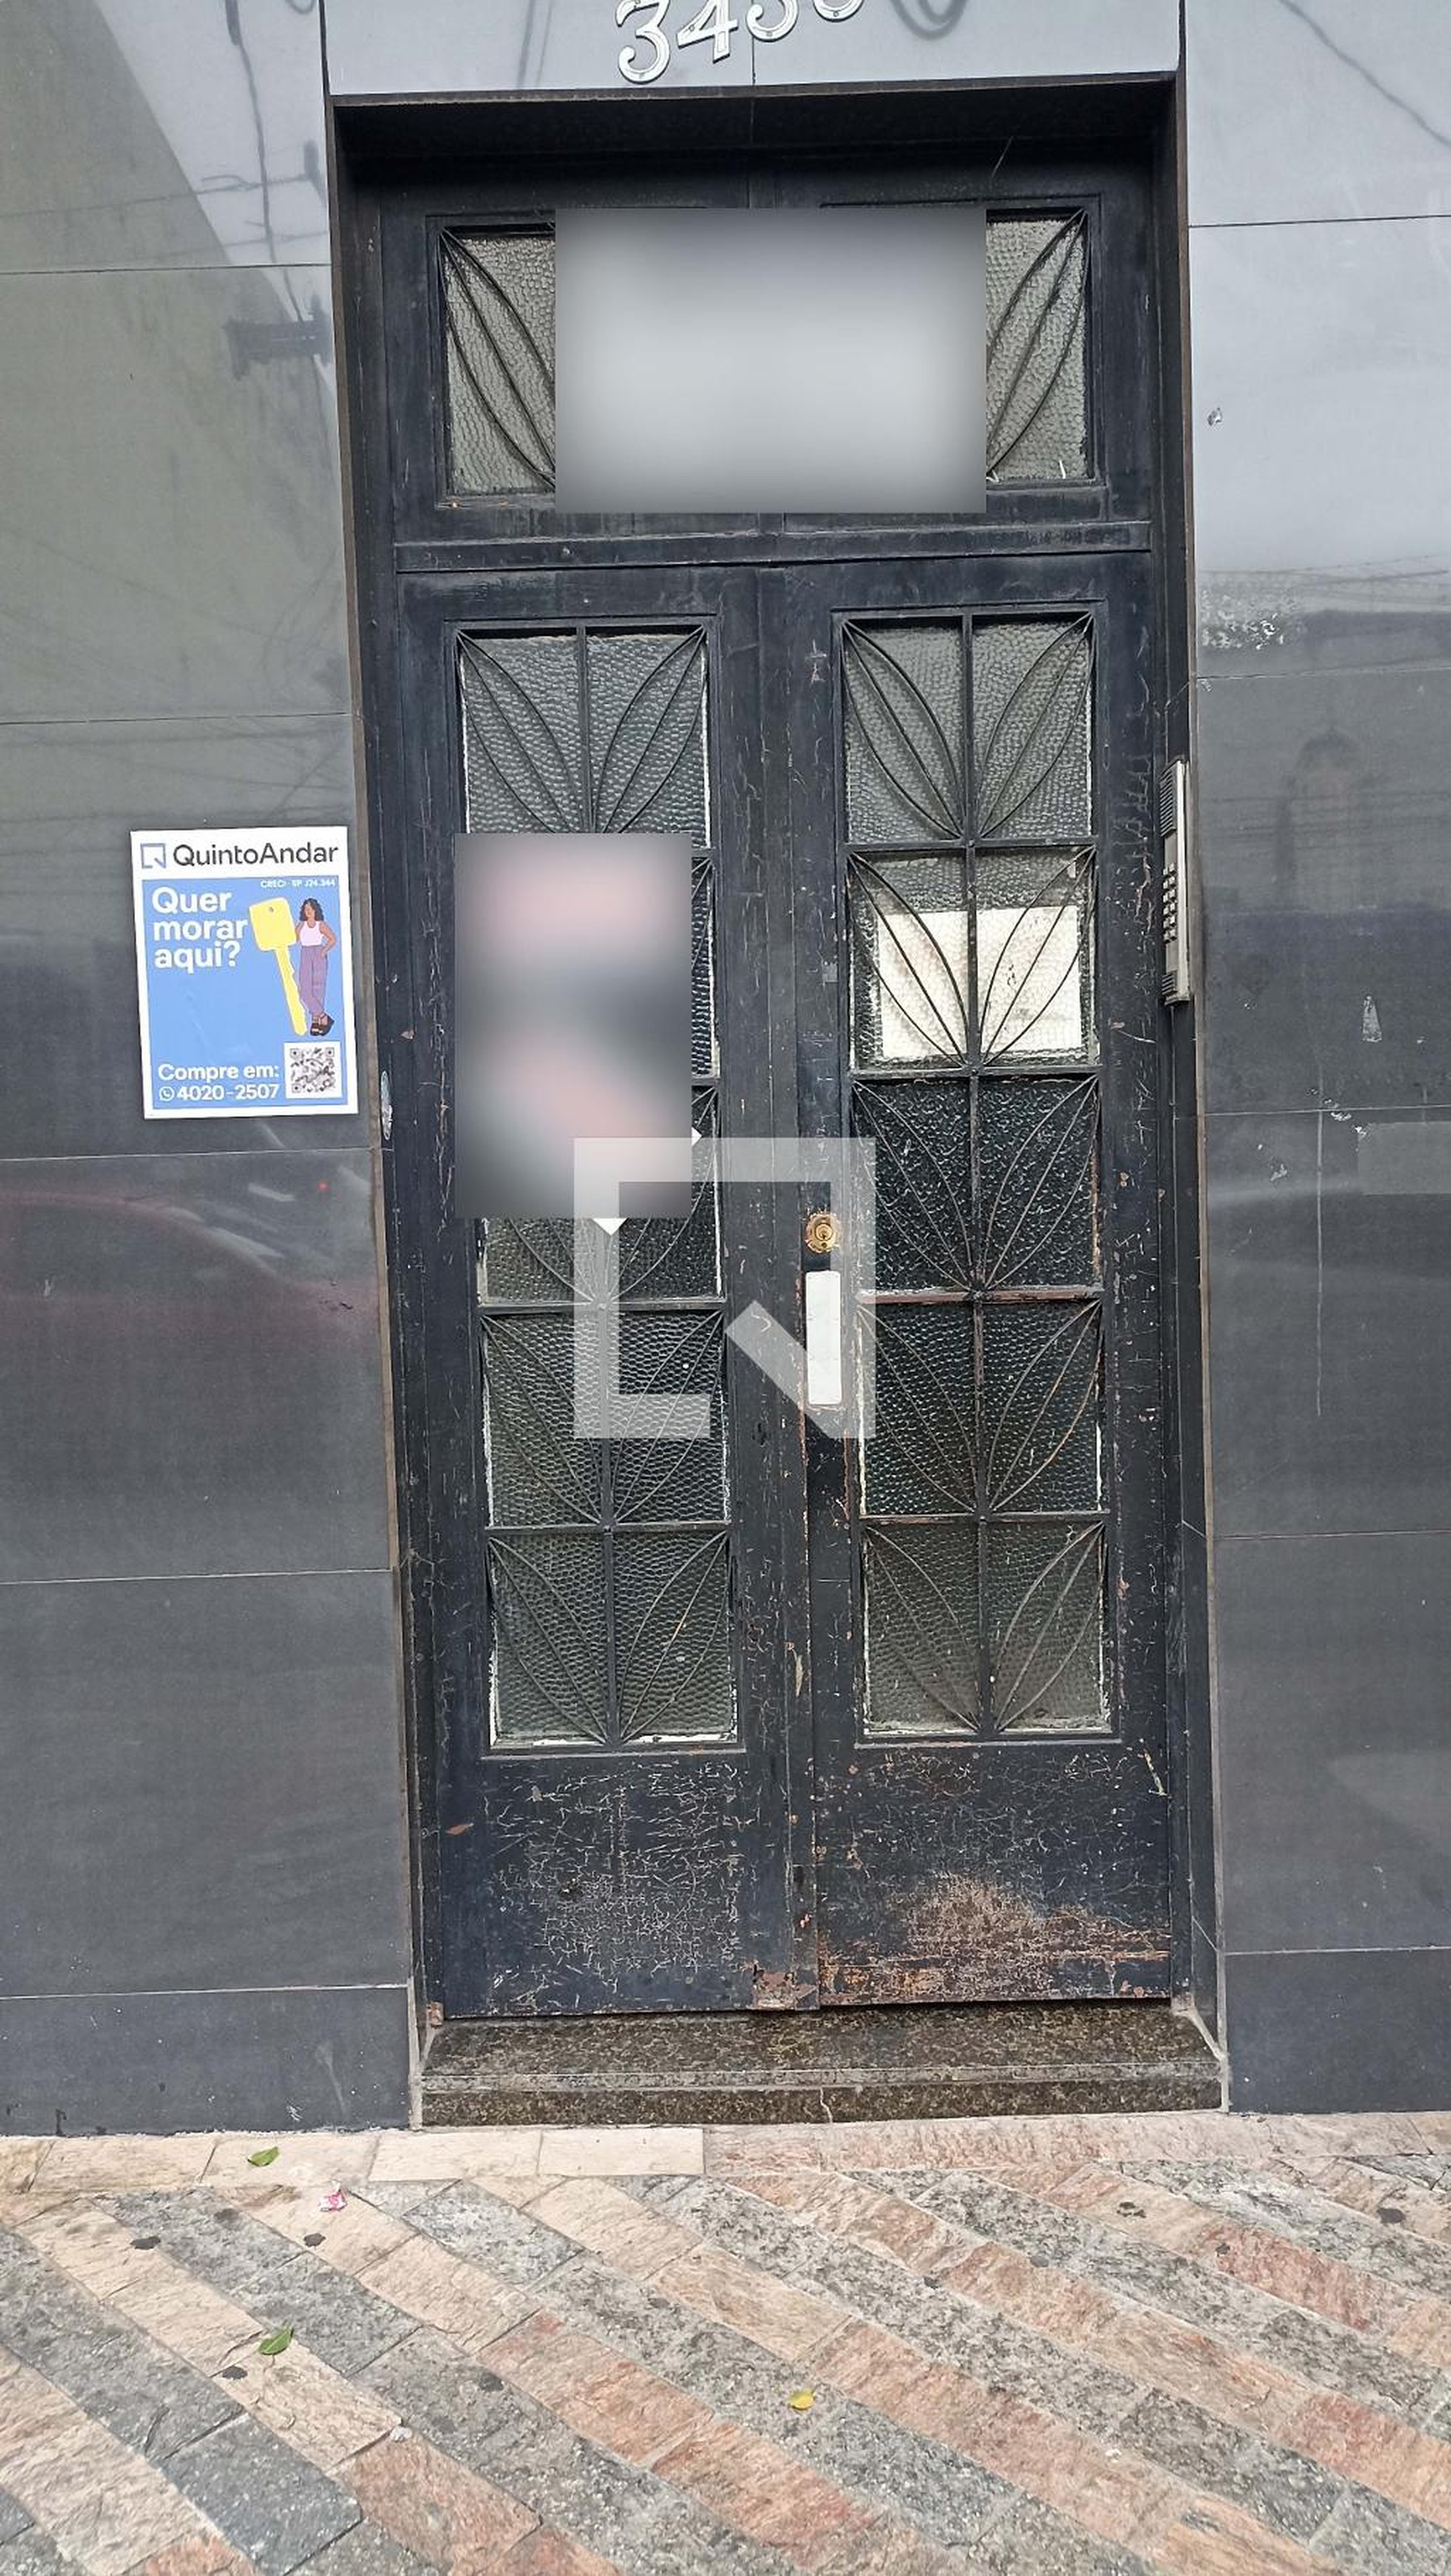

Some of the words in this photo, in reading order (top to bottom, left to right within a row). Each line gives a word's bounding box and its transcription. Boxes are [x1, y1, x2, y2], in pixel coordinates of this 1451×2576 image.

[173, 842, 339, 866] QuintoAndar
[152, 886, 232, 914] Quer
[153, 919, 248, 940] morar
[154, 940, 241, 974] aqui?
[158, 1064, 239, 1082] Compre
[243, 1065, 279, 1078] em:
